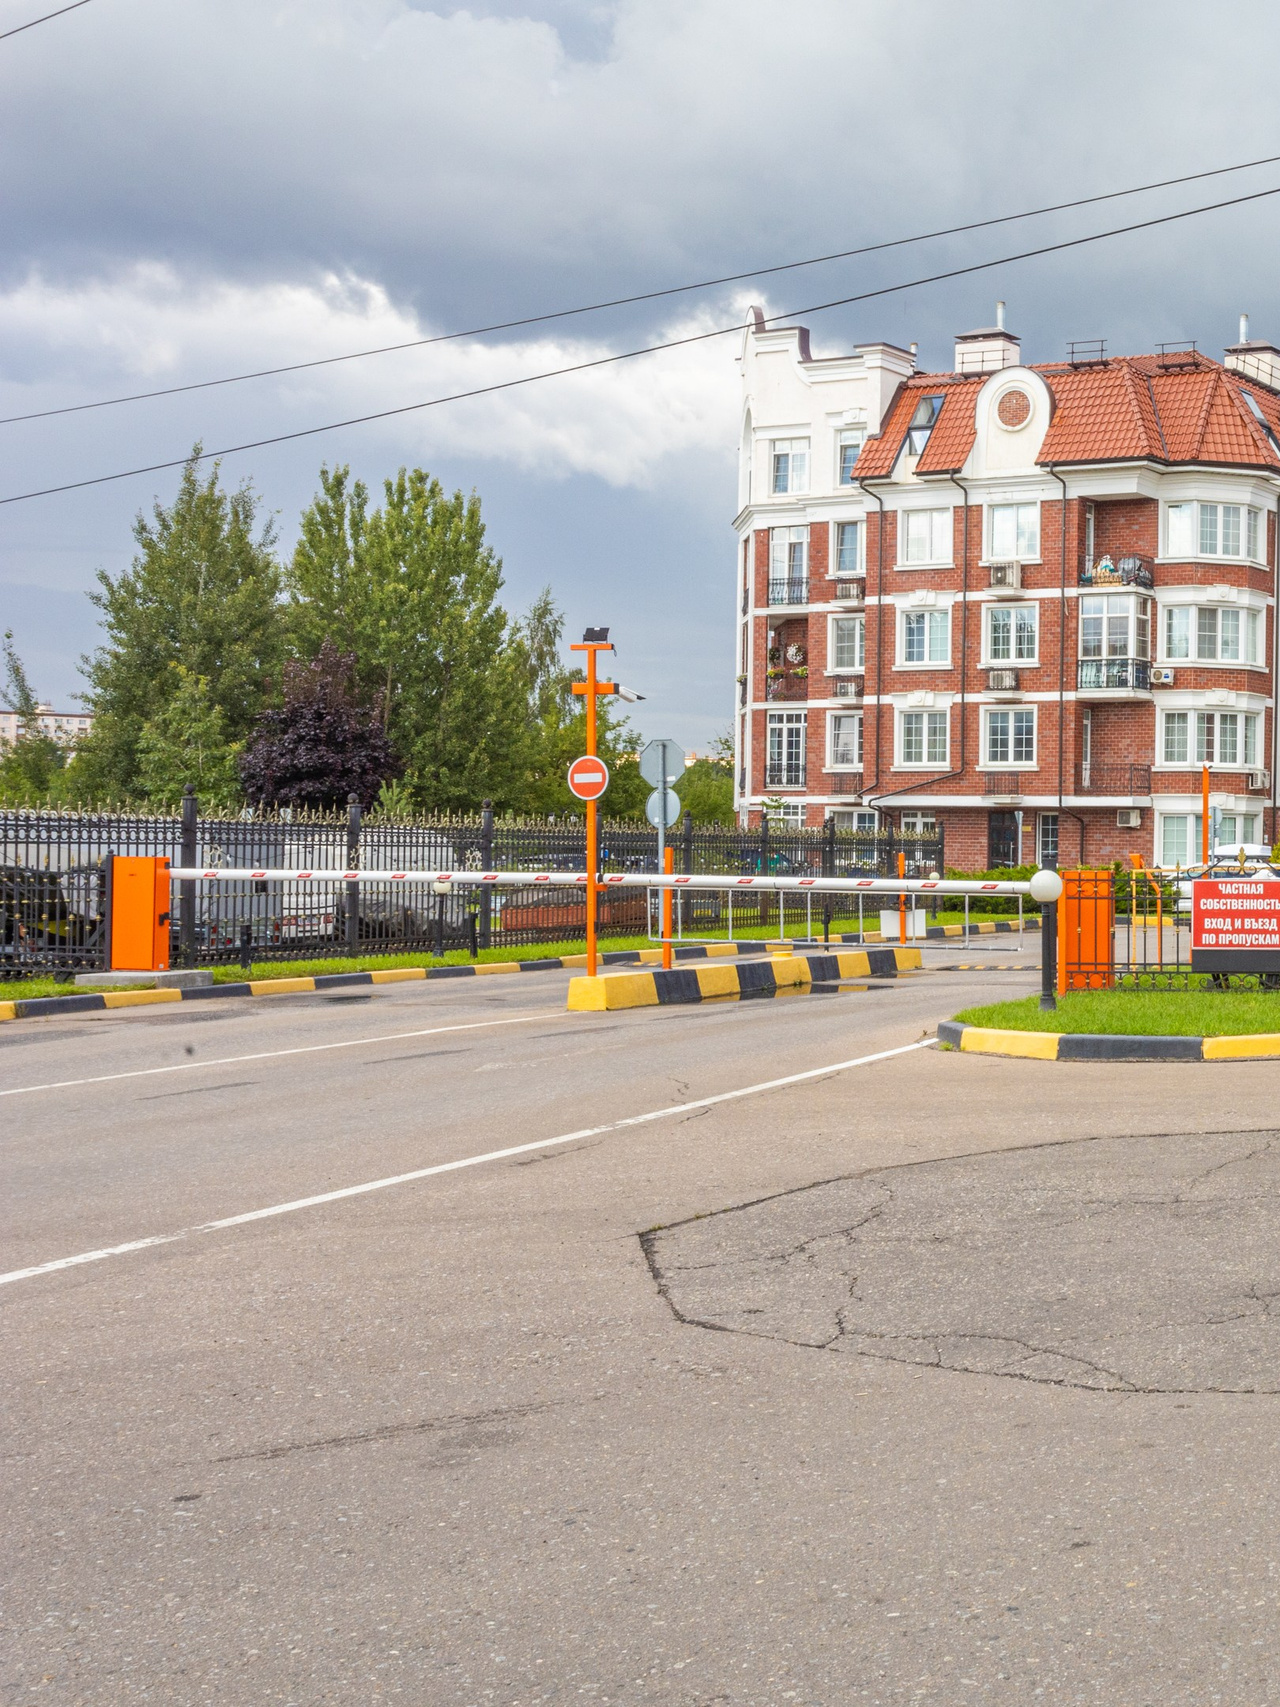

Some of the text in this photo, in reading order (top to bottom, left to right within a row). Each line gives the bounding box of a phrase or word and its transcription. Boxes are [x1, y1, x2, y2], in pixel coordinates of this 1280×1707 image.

[1218, 883, 1264, 895] ЧАСТНАЯ
[1204, 918, 1278, 931] ВХОД И ВЪЕЗД
[1202, 933, 1280, 946] ПО ПРОПУСКАМ
